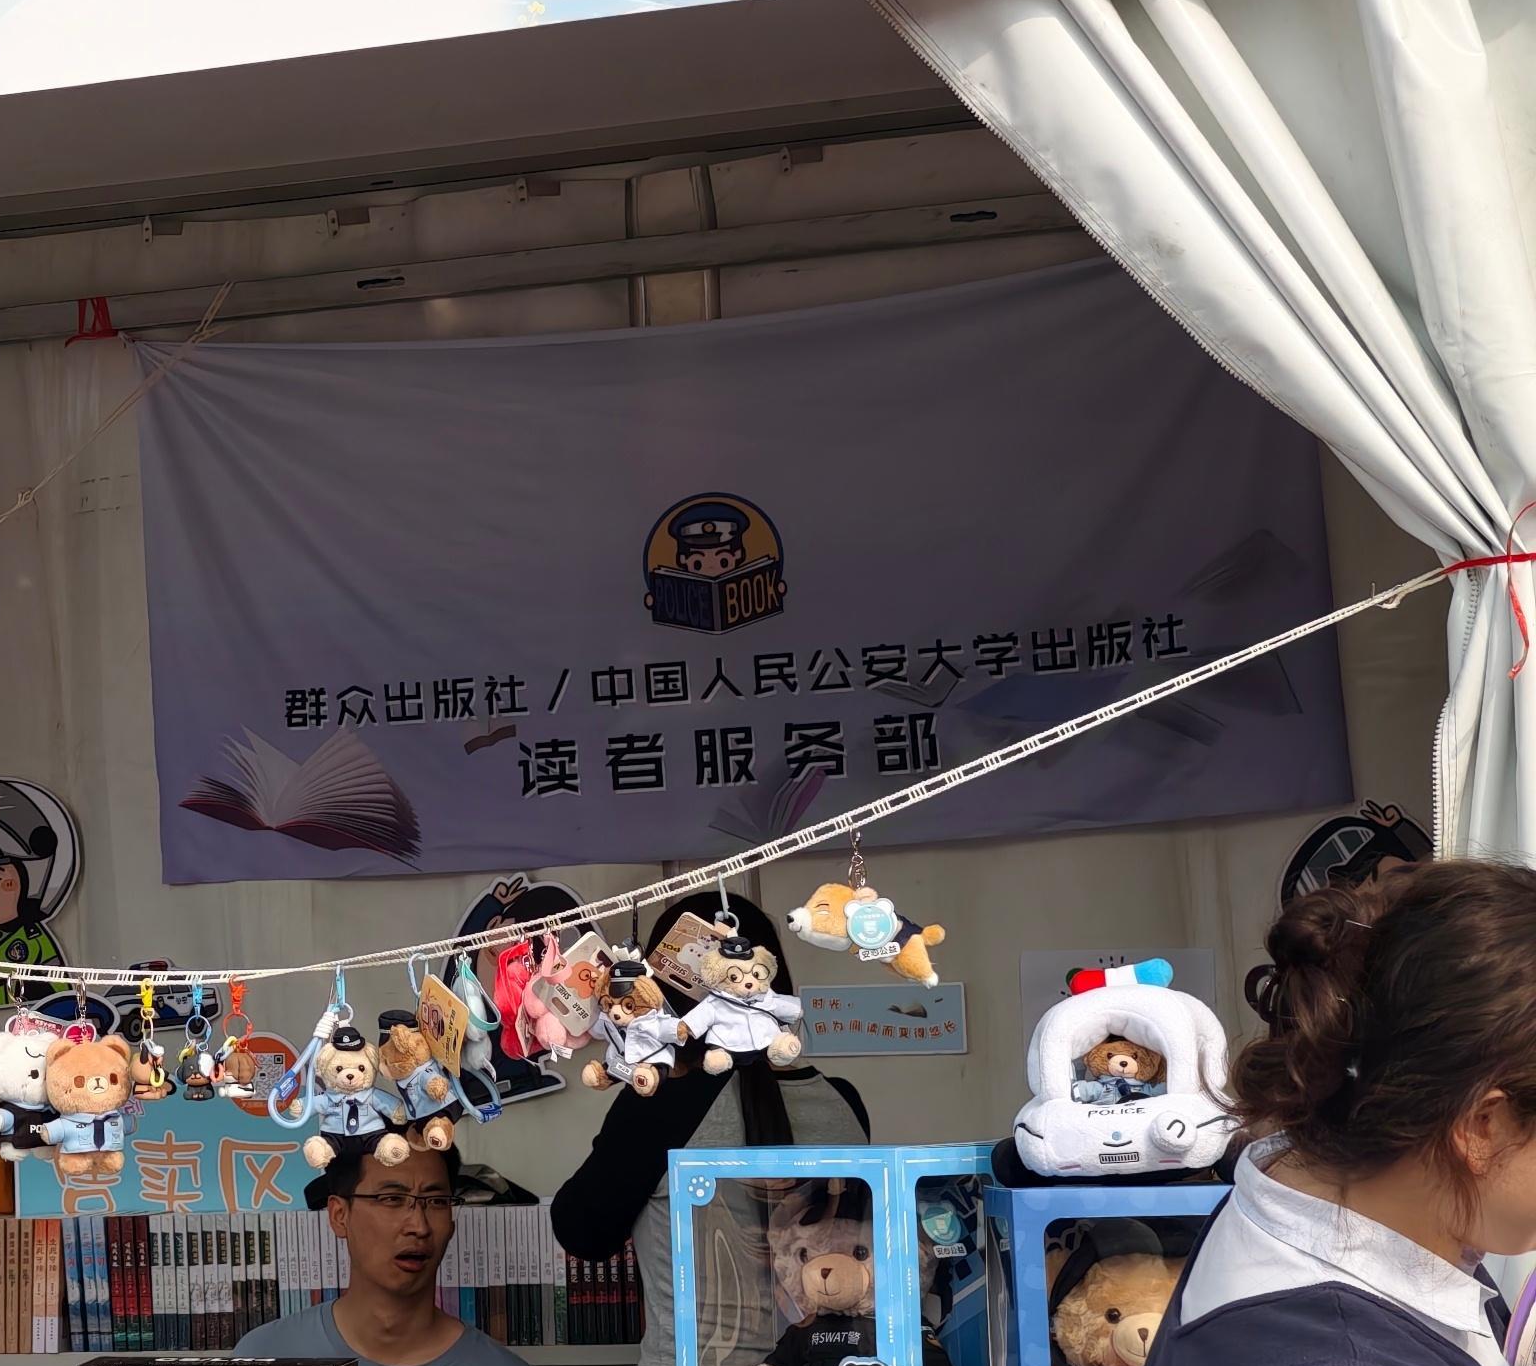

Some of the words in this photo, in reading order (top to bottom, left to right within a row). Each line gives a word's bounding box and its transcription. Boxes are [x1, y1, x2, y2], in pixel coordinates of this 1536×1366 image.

[726, 569, 780, 624] BOOK
[284, 668, 529, 730] 群众出版社
[591, 611, 1190, 709] 中国人民公安大学出版社
[518, 713, 945, 799] 读者服务部
[1087, 1106, 1147, 1118] POLICE
